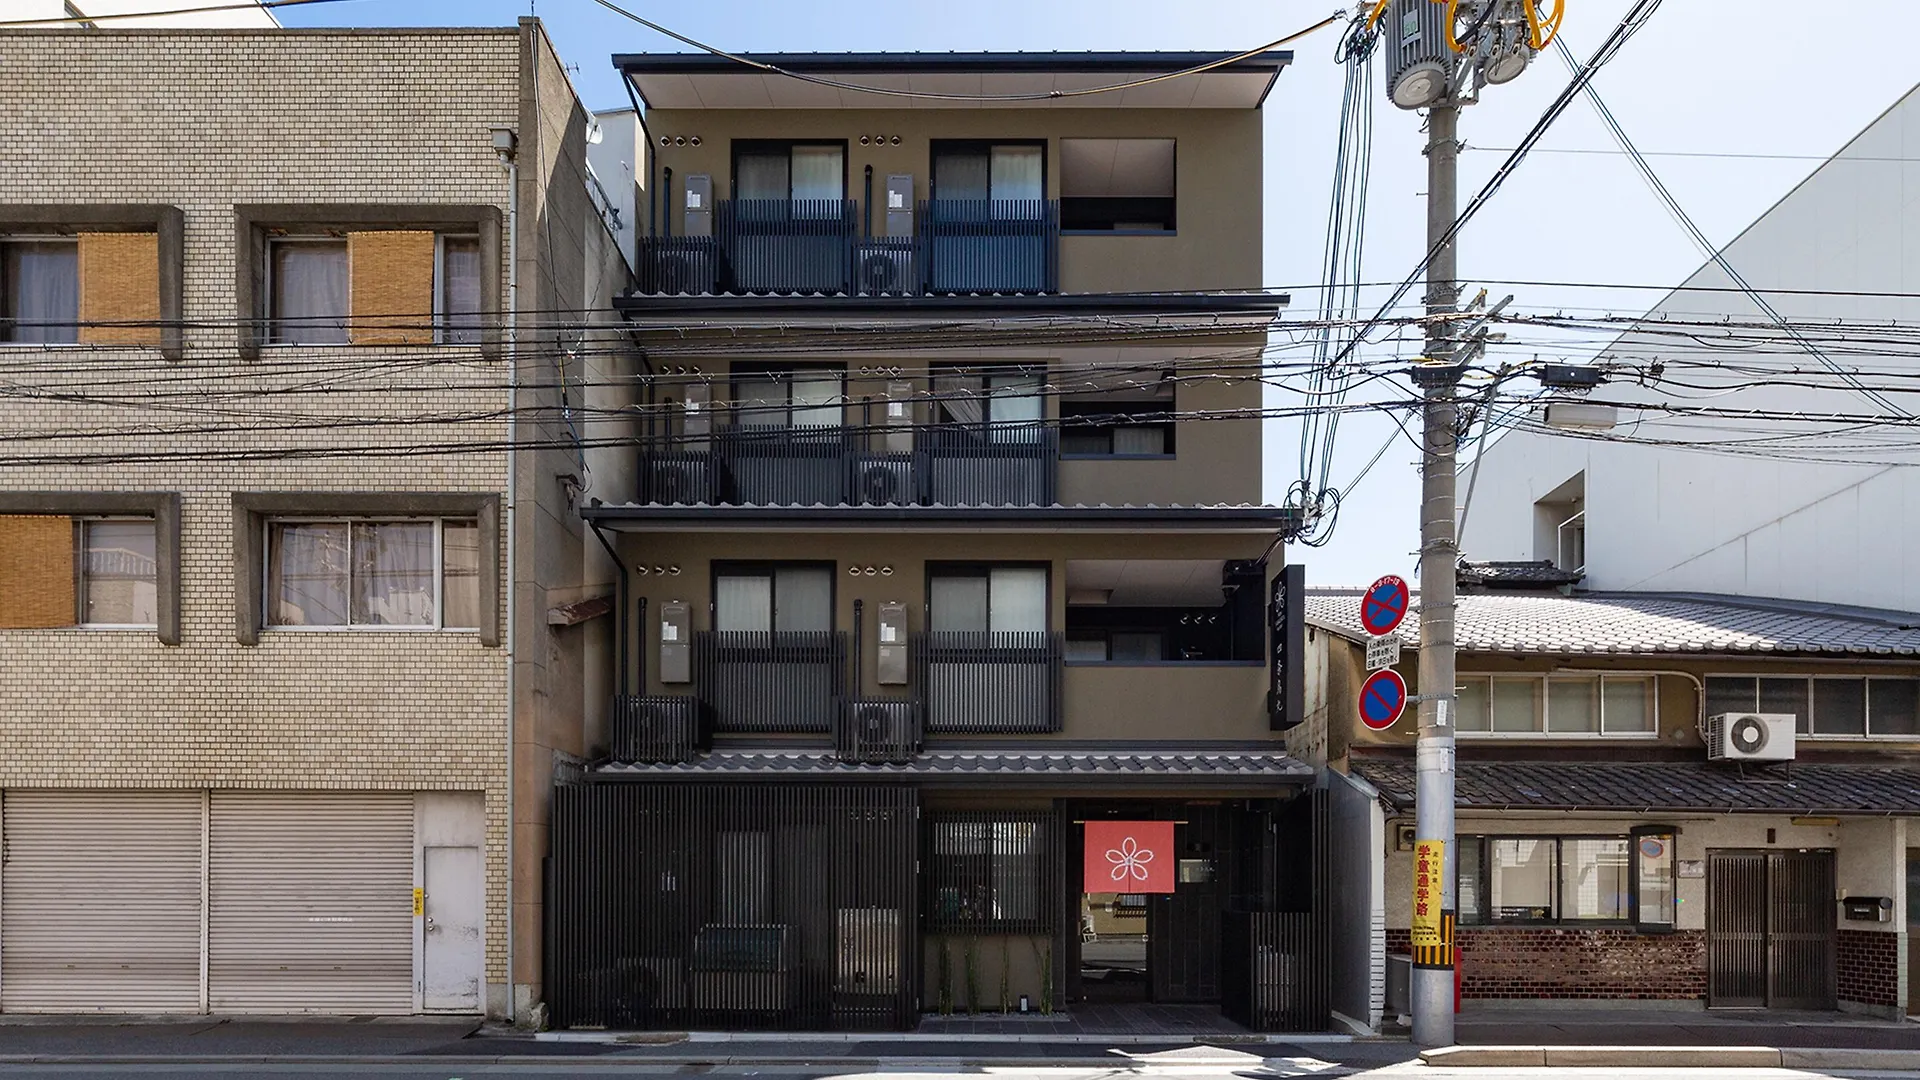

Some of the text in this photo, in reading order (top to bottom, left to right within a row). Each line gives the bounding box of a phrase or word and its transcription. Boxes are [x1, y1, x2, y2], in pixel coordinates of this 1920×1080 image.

[1416, 845, 1431, 917] 学童通学路
